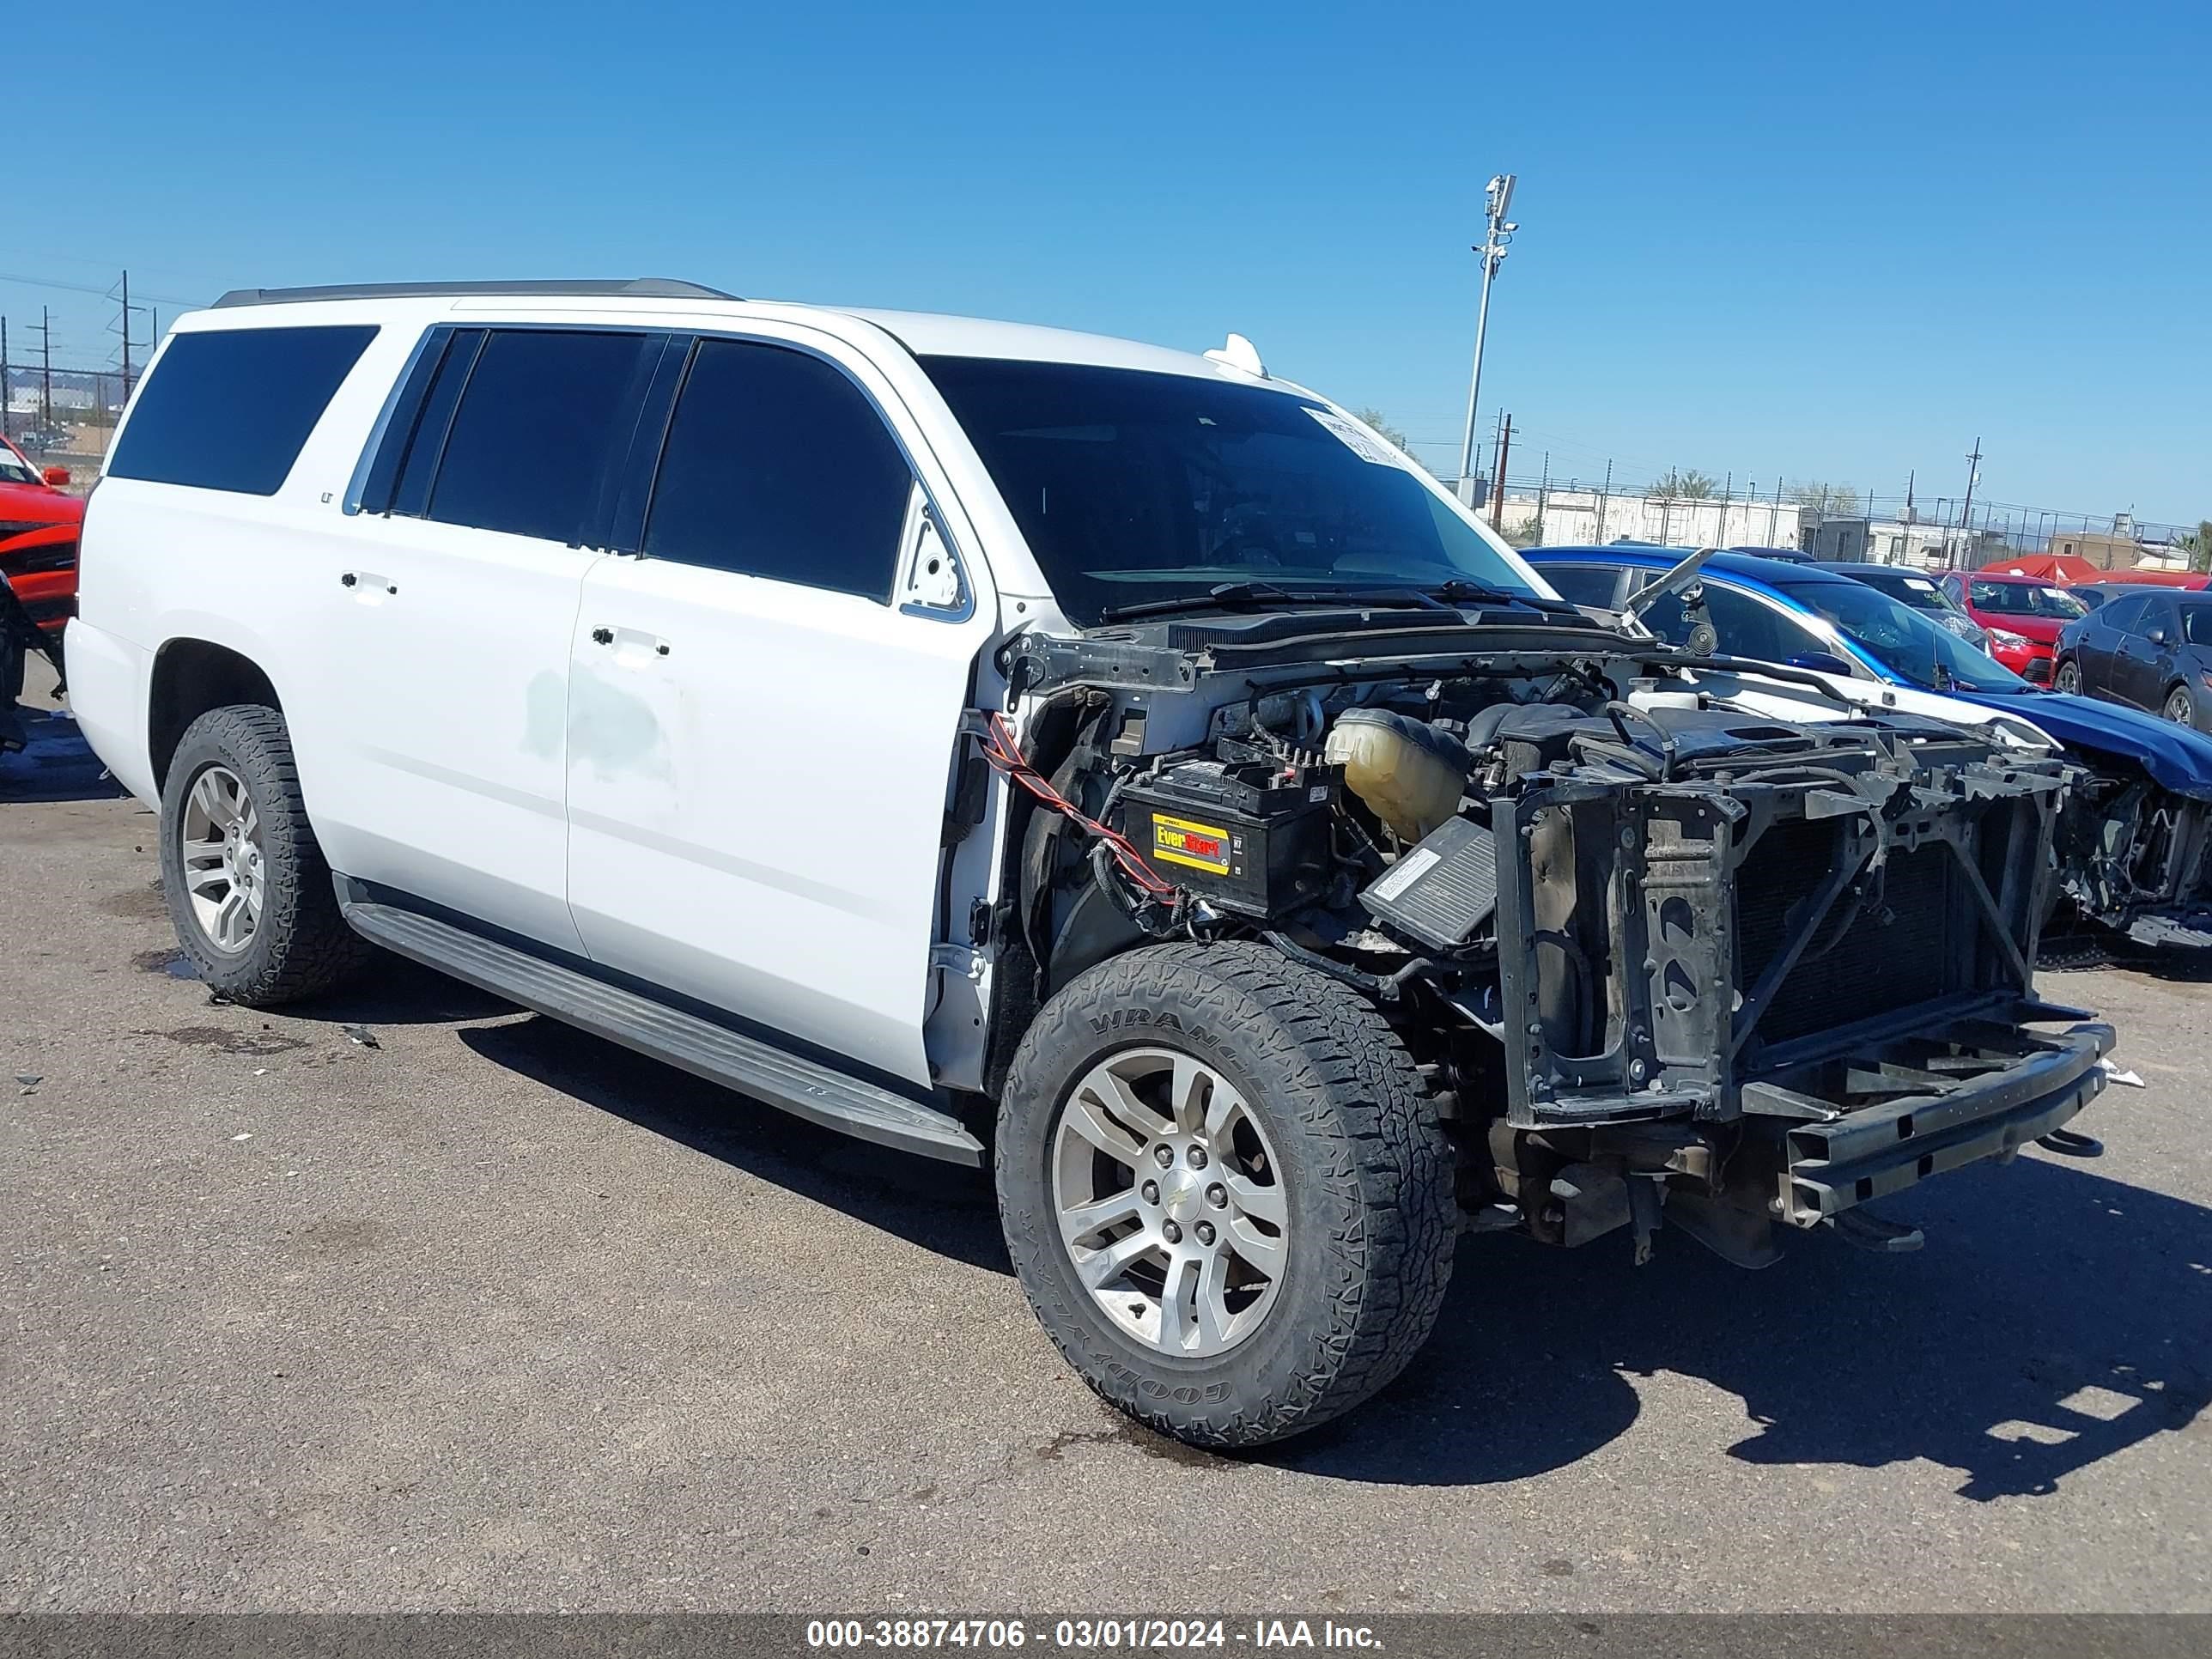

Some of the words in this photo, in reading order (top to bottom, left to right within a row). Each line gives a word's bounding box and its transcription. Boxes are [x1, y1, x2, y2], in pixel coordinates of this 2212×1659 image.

[320, 491, 334, 504] LT
[1157, 825, 1220, 859] EverStart
[1088, 1008, 1310, 1189] WRANGLER
[1018, 1207, 1234, 1406] GOODYEAR
